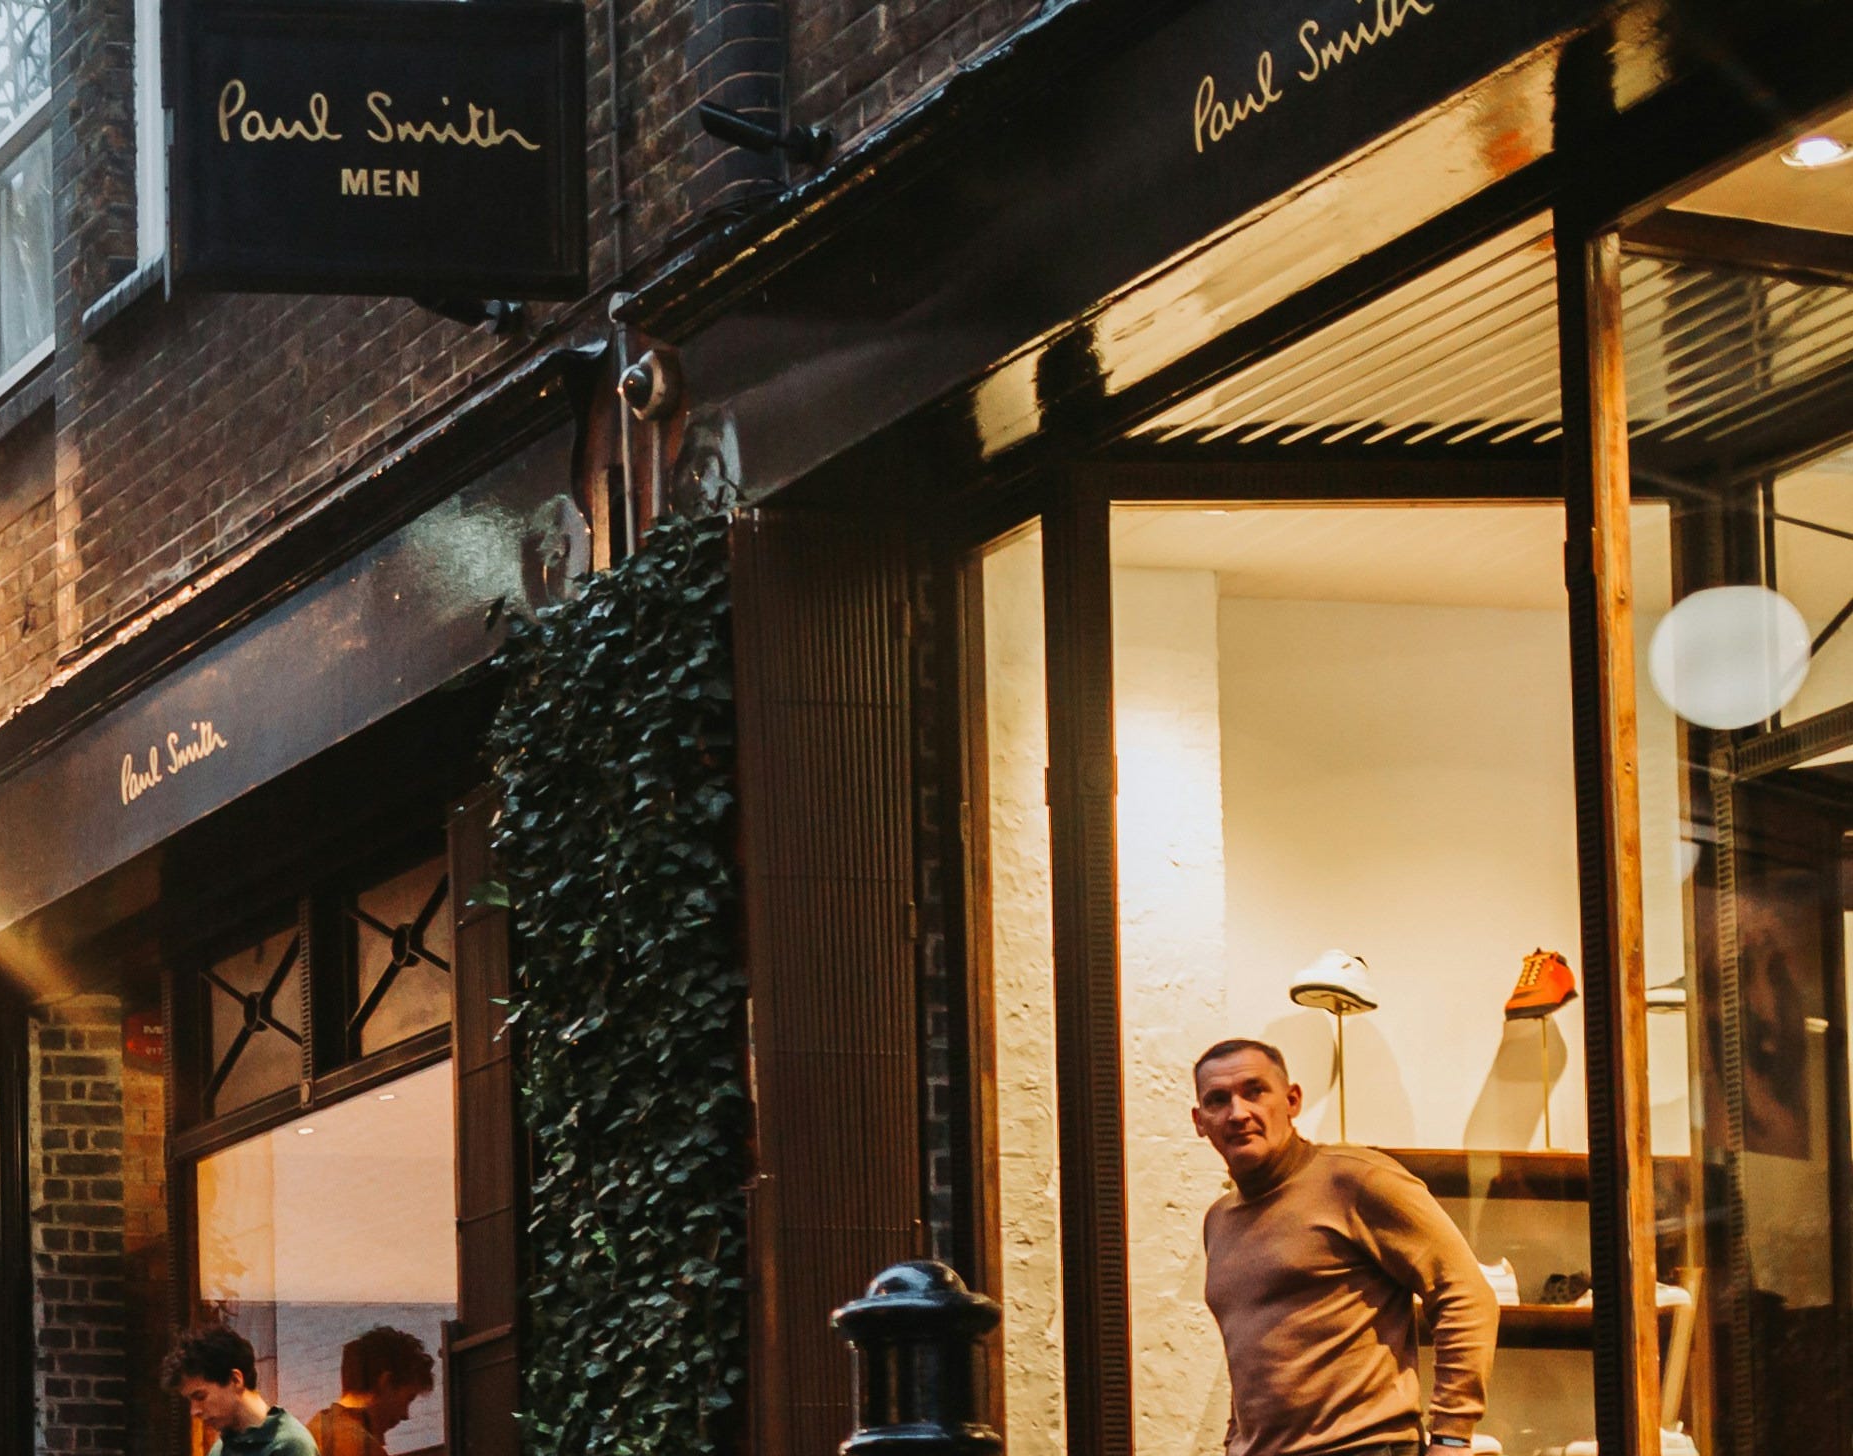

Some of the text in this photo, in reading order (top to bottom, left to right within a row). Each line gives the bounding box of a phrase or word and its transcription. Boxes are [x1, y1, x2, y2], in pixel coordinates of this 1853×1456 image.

[218, 79, 541, 150] Paul Smith
[1194, 50, 1283, 153] Paul
[341, 168, 420, 197] MEN
[120, 721, 228, 805] Paul Smith
